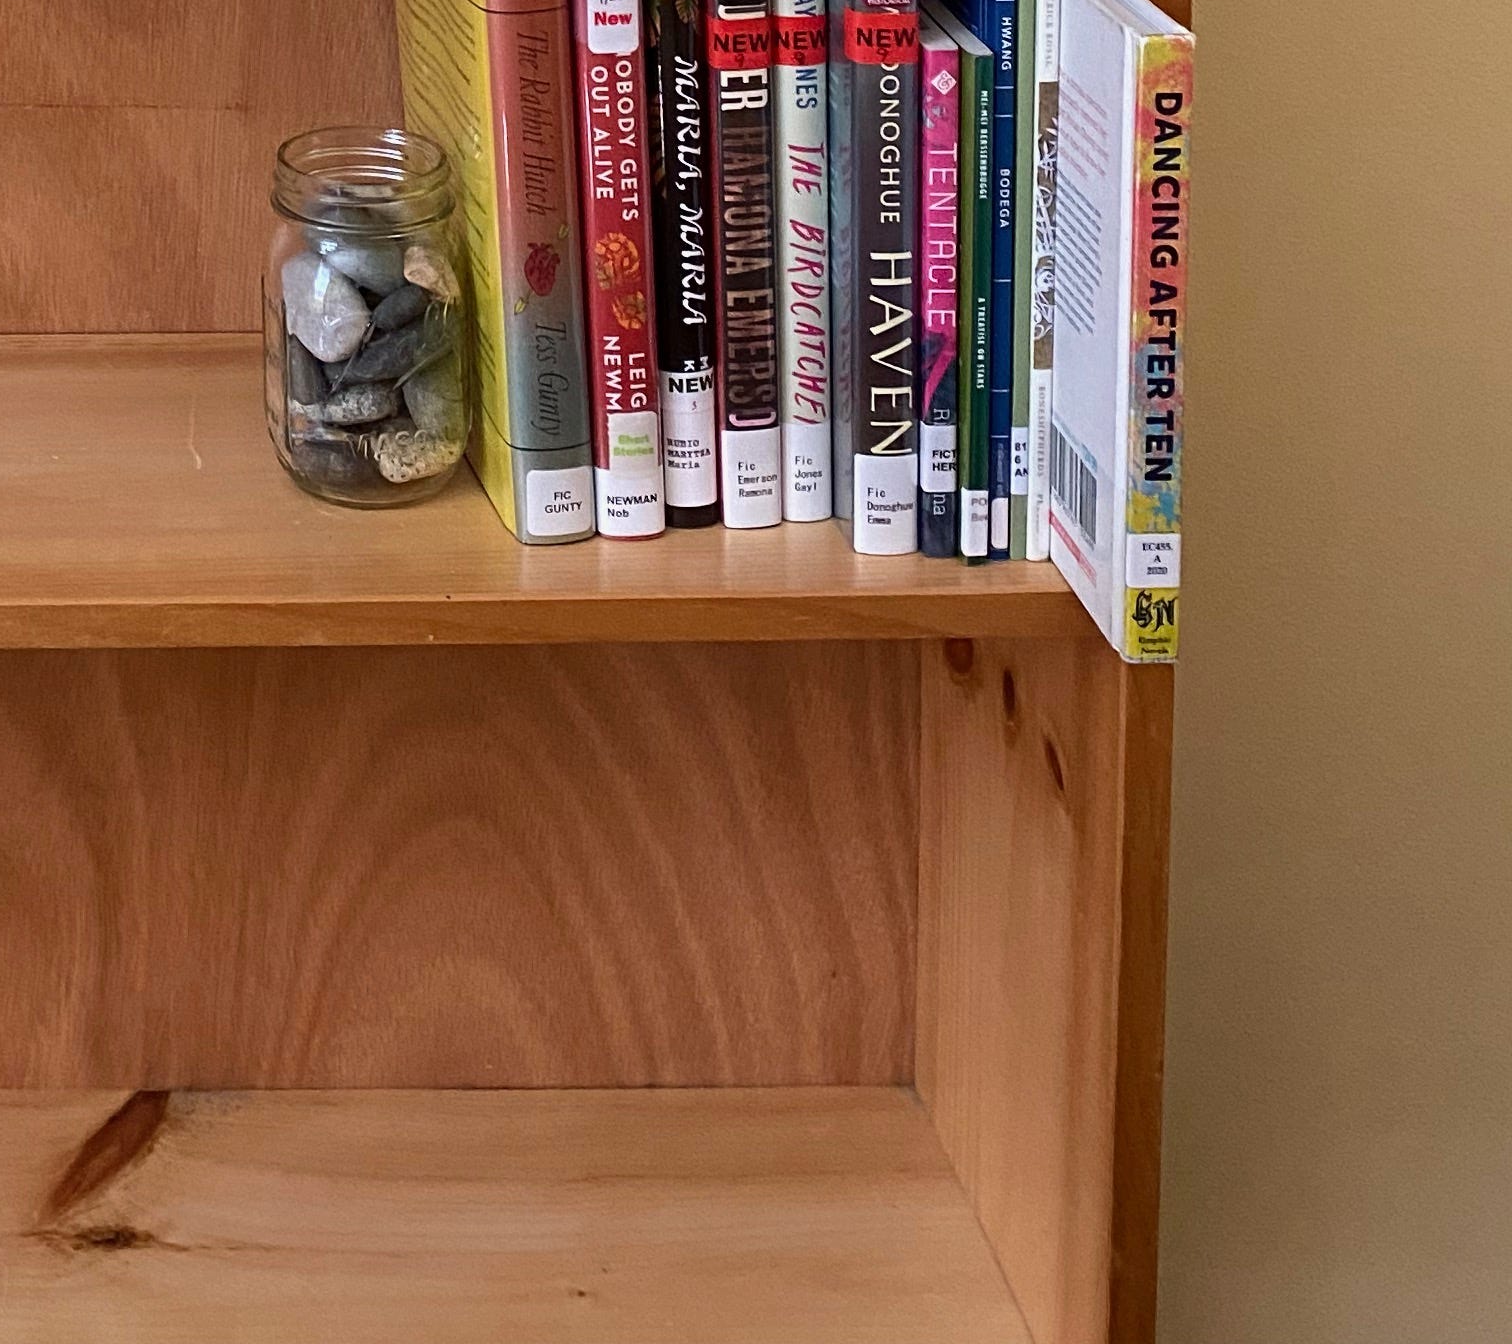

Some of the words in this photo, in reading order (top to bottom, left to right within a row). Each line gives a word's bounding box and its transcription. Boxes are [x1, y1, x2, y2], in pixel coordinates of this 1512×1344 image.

[594, 10, 633, 27] New
[714, 33, 770, 52] NEW
[855, 28, 917, 47] NEW
[1001, 17, 1012, 71] HWANG
[593, 66, 609, 116] OUT
[675, 54, 703, 190] MARIA,
[594, 130, 614, 200] ALIVE
[1153, 91, 1184, 270] DANCING
[998, 169, 1010, 229] BODEGA
[927, 142, 958, 328] TENTACLE
[681, 207, 708, 326] MARIA
[869, 251, 912, 456] HAVEN
[1146, 281, 1179, 400] AFTER
[668, 375, 714, 394] NEW
[1143, 409, 1173, 482] TEN
[545, 502, 582, 513] GUNTY
[554, 491, 571, 501] FIC
[607, 494, 658, 506] NEWMAN
[608, 509, 629, 518] Nob
